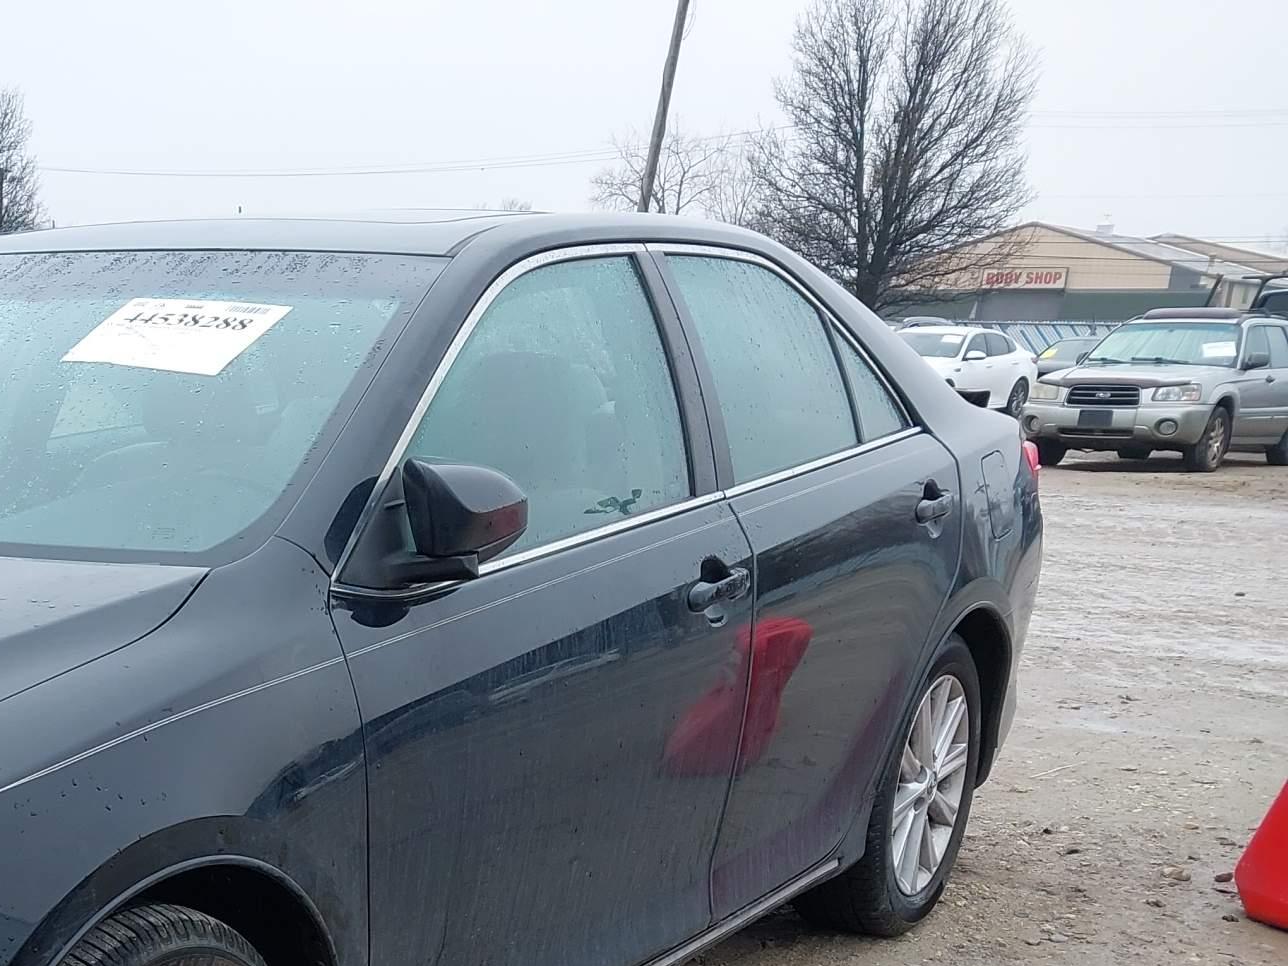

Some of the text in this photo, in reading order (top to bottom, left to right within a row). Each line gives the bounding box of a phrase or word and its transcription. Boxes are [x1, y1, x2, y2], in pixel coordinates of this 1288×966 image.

[985, 271, 1062, 285] BODY SHOP
[124, 312, 253, 331] 44538288
